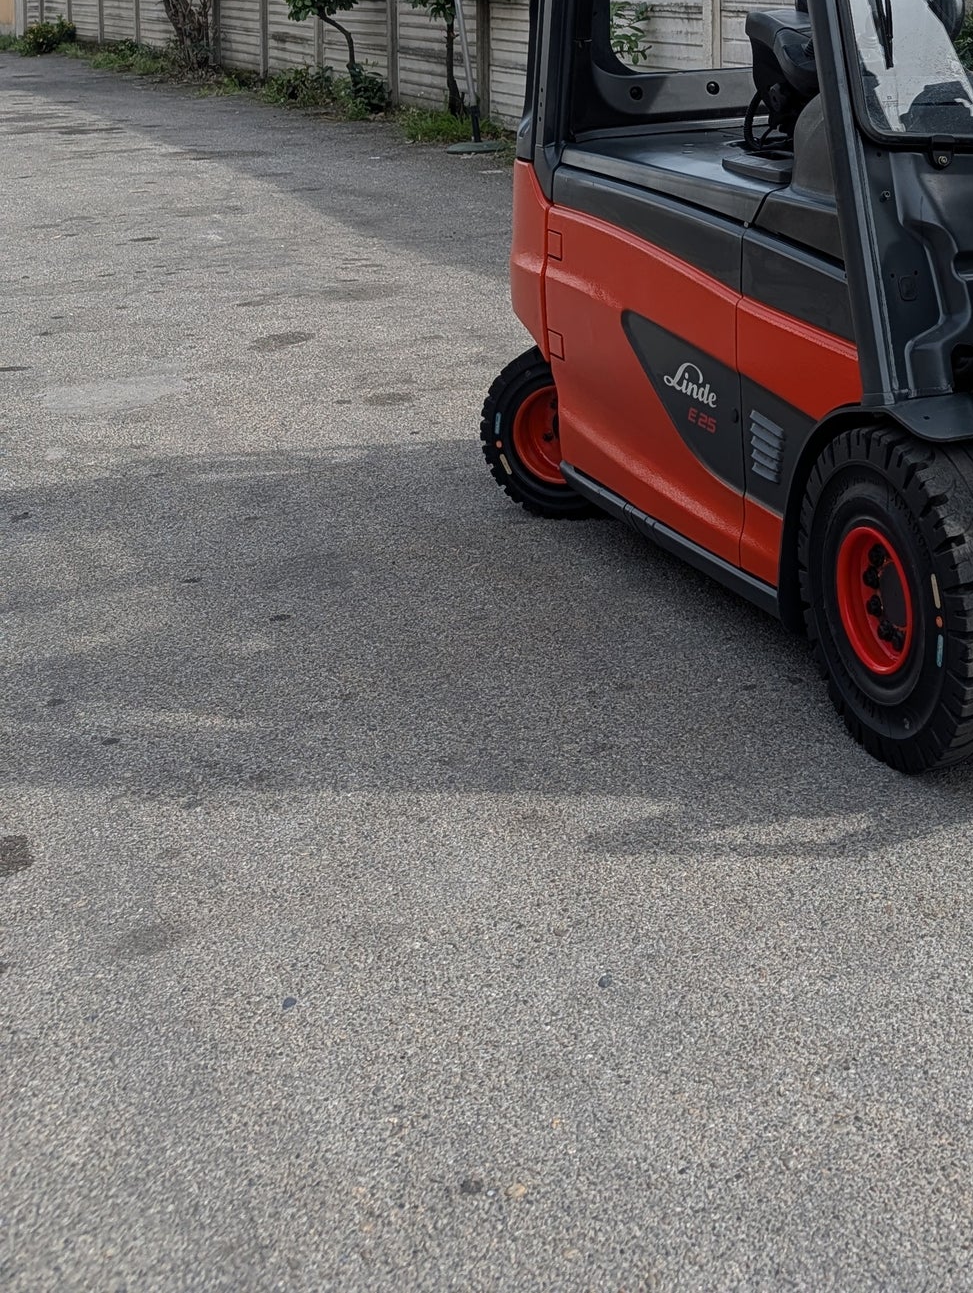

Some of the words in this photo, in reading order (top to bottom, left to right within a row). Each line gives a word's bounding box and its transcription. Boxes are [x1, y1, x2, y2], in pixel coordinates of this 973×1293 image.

[663, 362, 717, 408] Linde
[687, 407, 698, 423] E
[697, 412, 717, 434] 25
